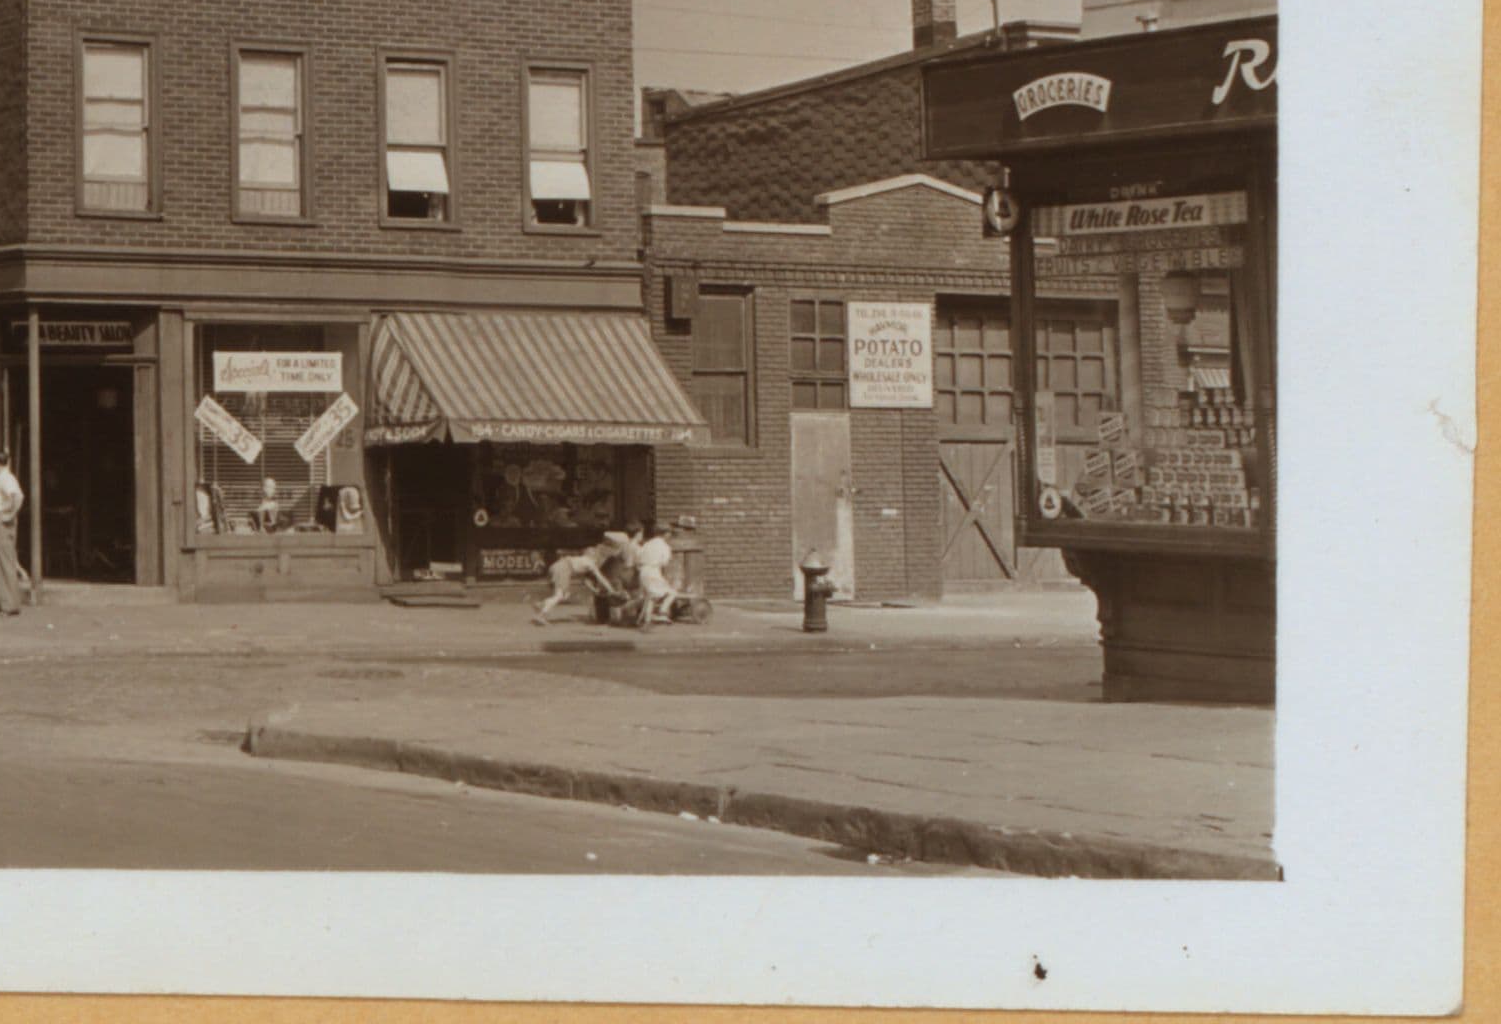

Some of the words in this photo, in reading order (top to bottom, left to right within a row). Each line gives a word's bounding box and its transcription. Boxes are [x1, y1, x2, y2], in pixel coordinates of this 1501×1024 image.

[1017, 77, 1103, 113] GROCERIES
[1070, 206, 1122, 230] White
[1125, 204, 1170, 226] Rose
[1171, 200, 1203, 223] Tea
[854, 339, 923, 357] POTATO
[483, 556, 532, 569] MODEL
